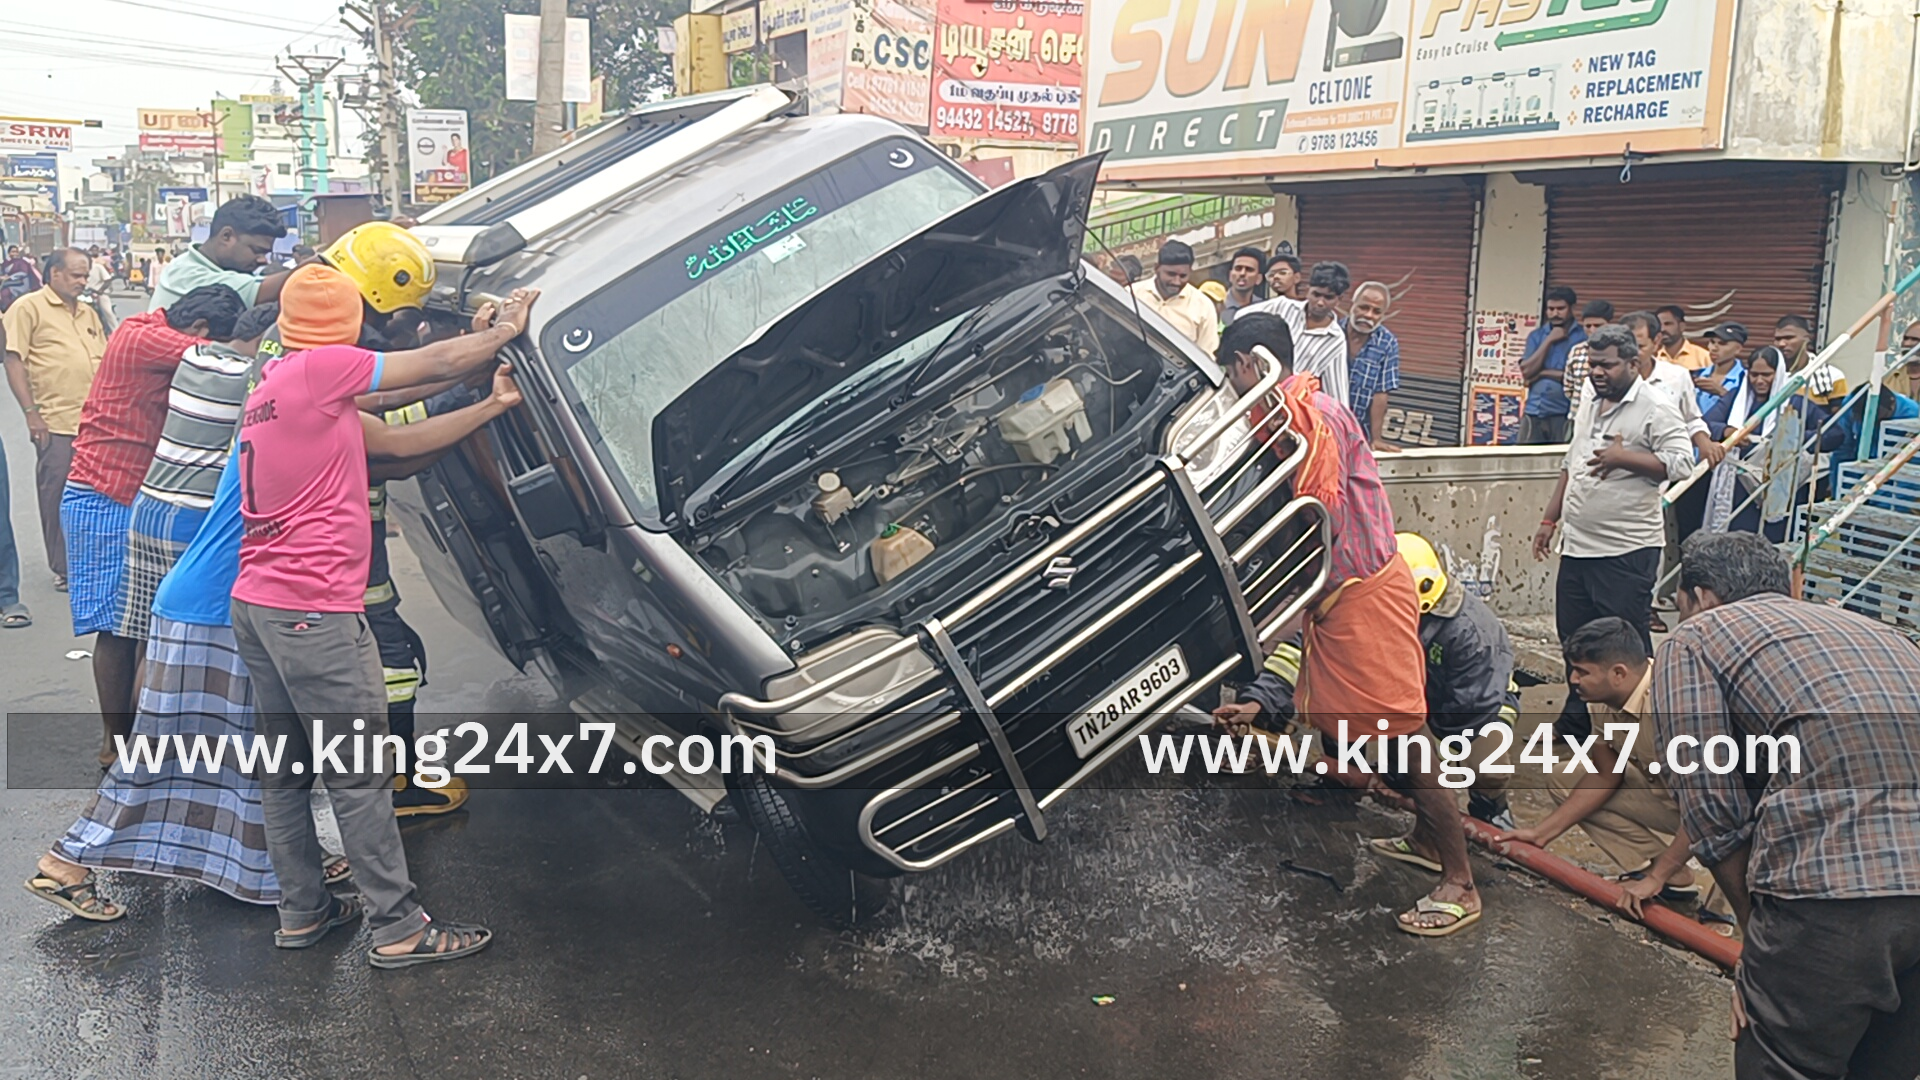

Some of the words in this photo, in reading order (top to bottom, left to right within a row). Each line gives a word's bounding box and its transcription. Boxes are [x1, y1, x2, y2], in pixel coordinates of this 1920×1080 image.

[874, 33, 930, 71] CSC
[1097, 0, 1313, 107] SUN
[1416, 48, 1439, 61] Easy
[1441, 45, 1452, 58] to
[1454, 39, 1489, 55] Cruise
[1588, 53, 1624, 74] NEW
[1627, 49, 1657, 69] TAG
[1308, 75, 1374, 105] CELTONE
[1585, 70, 1703, 99] REPLACEMENT
[936, 106, 983, 129] 94432
[1042, 112, 1078, 135] 8778
[1583, 100, 1669, 124] RECHARGE
[10, 123, 70, 139] SRM
[1096, 108, 1276, 153] DIRECT
[1311, 134, 1336, 150] 9788
[1340, 130, 1378, 149] 123456
